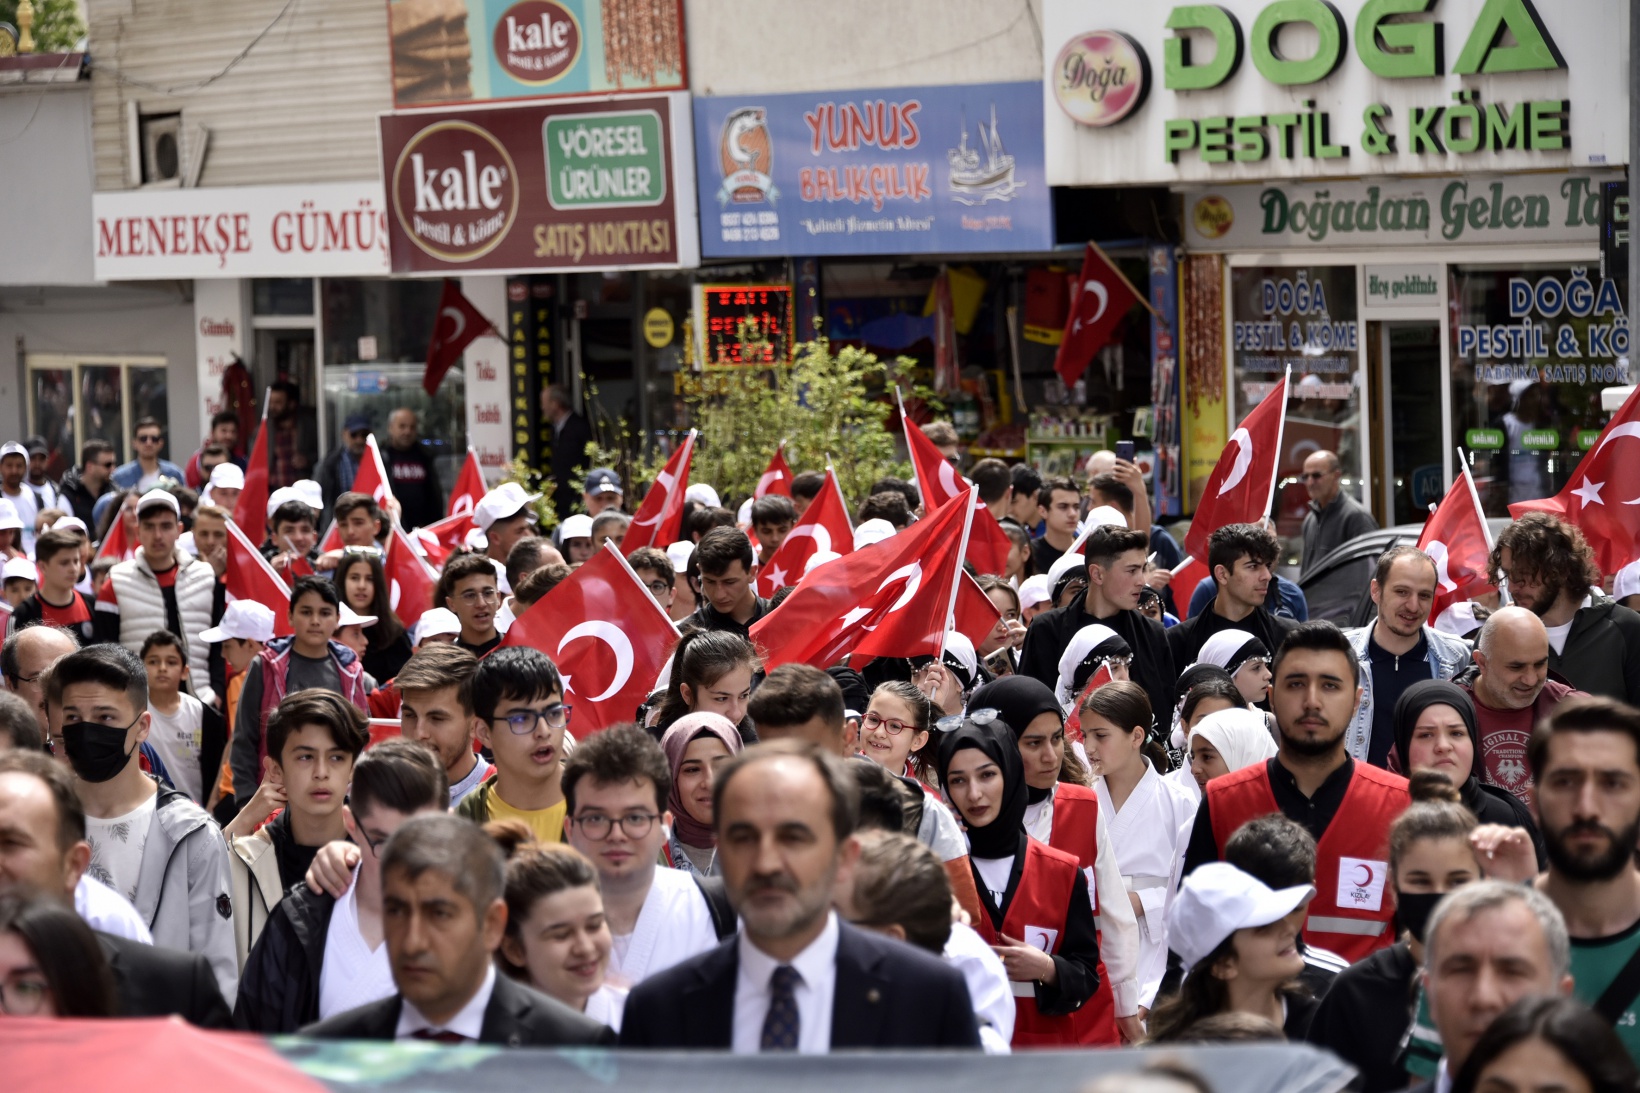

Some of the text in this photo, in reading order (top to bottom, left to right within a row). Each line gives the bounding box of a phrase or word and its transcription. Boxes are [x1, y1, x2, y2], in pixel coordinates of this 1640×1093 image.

[506, 12, 569, 51] kale
[1063, 53, 1128, 102] Doğa
[557, 123, 649, 159] YÖRESEL
[803, 99, 924, 156] YUNUS
[1164, 89, 1571, 165] PESTİL & KÖME
[410, 149, 503, 213] kale
[558, 164, 652, 200] ÜRÜNLER
[798, 161, 931, 212] BALIKÇILIK
[413, 210, 506, 247] pestil & köme
[1259, 186, 1430, 242] Doğadan
[1439, 180, 1551, 241] Gelen
[96, 211, 253, 269] MENEKŞE
[533, 219, 671, 263] SATIŞ NOKTASI
[1262, 269, 1328, 316] DOĞA
[1509, 266, 1624, 318] DOĞA
[1234, 315, 1287, 350] PESTİL
[1289, 320, 1304, 350] &
[1306, 315, 1358, 350] KÖME
[1458, 316, 1549, 359] PESTİL
[1555, 323, 1583, 359] &
[1475, 363, 1540, 383] FABRİKA
[1543, 363, 1587, 386] SATIŞ
[1471, 432, 1499, 445] SAĞLIKLI
[1523, 433, 1555, 447] GÜVENİLİR
